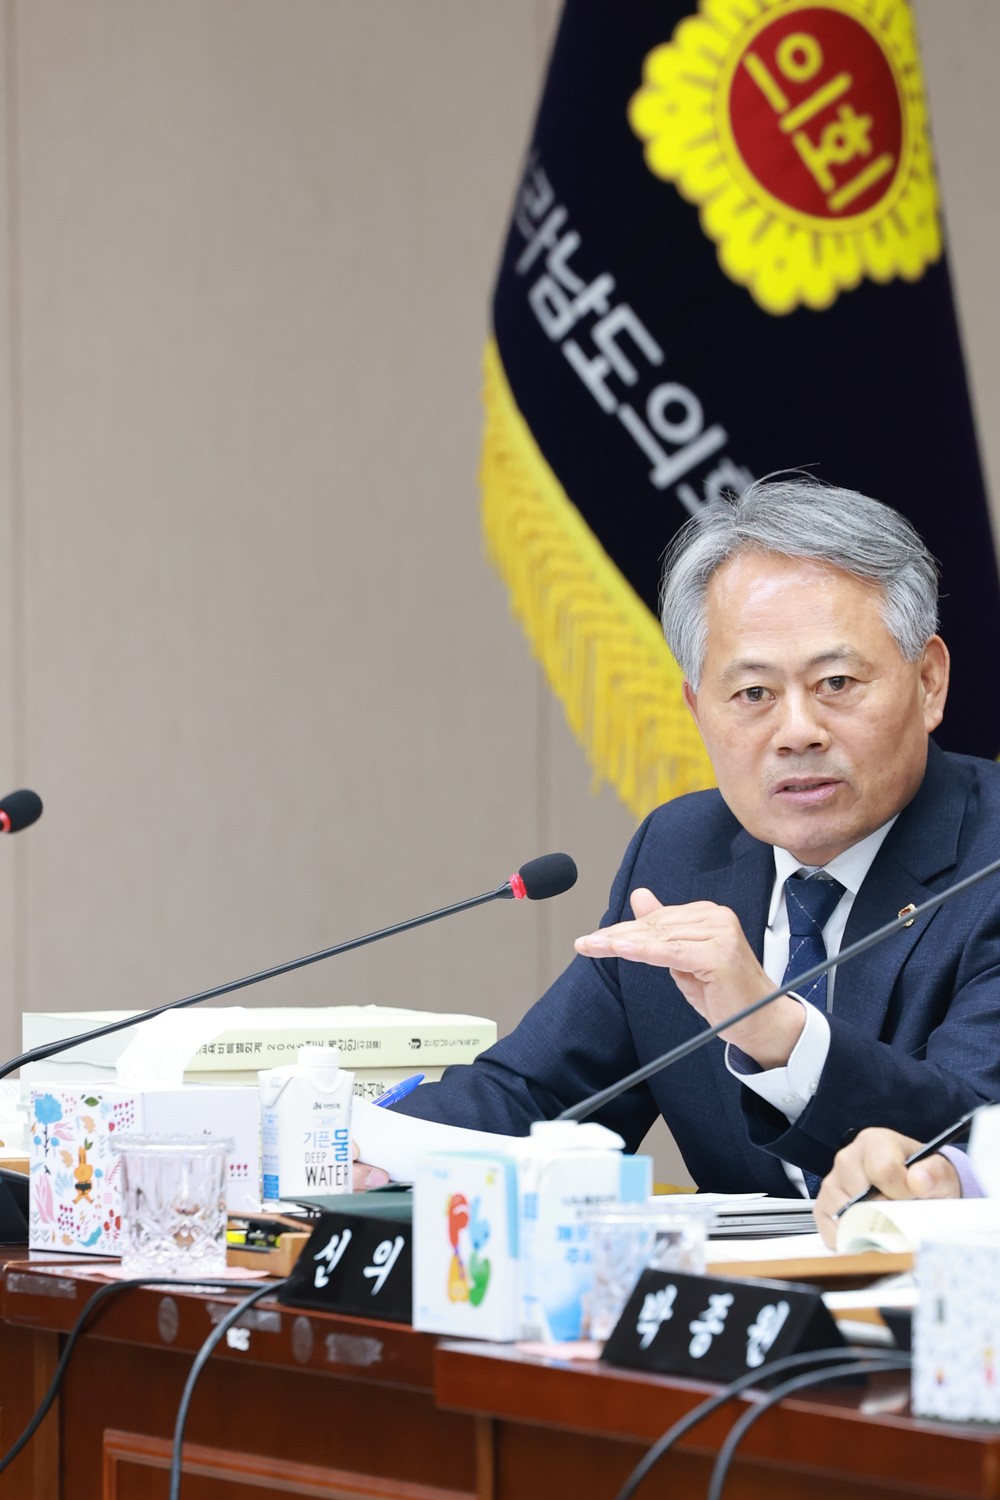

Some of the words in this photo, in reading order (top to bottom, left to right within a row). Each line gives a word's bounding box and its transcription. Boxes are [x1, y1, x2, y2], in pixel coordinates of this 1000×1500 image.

[743, 32, 894, 212] 의회
[196, 1042, 263, 1055] 교육비특별회계
[303, 1131, 331, 1149] 기픈
[331, 1128, 349, 1162] 물
[304, 1151, 327, 1164] DEEP
[305, 1164, 349, 1187] WATER
[312, 1227, 406, 1297] 신의
